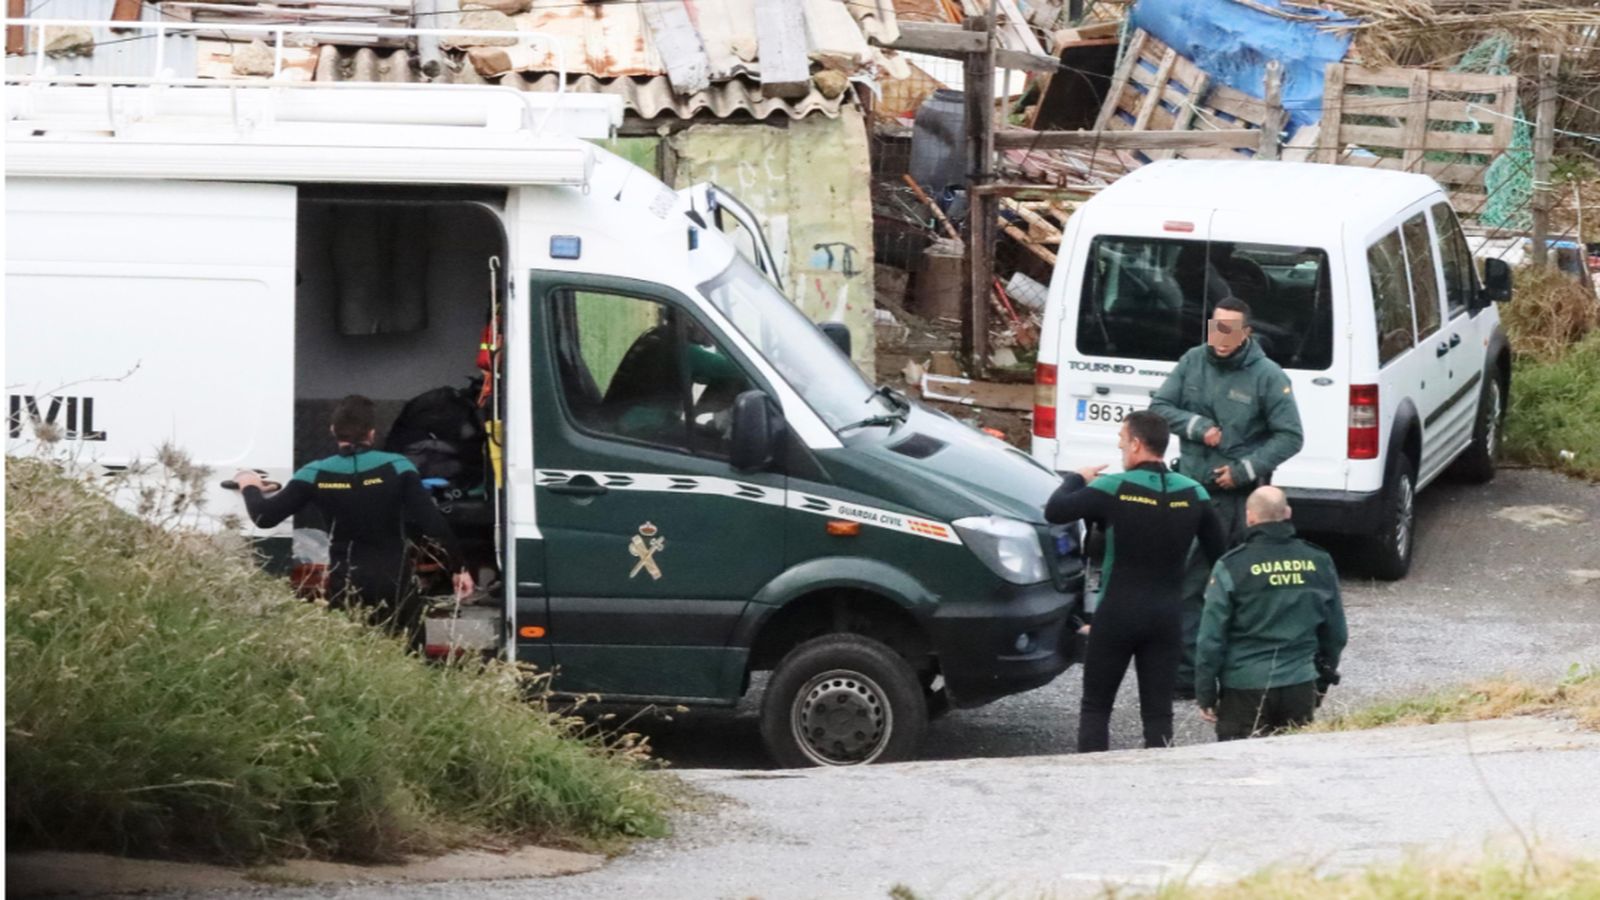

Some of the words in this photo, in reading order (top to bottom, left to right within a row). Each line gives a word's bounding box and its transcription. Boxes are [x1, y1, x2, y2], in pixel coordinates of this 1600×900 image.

[317, 482, 352, 490] GUARDIA
[363, 477, 384, 486] CIVIL
[1119, 494, 1158, 506] GUARDIA
[838, 505, 878, 521] GUARDIA
[880, 514, 903, 527] CIVIL
[1250, 560, 1317, 575] GUARDIA
[1269, 573, 1306, 586] CIVIL
